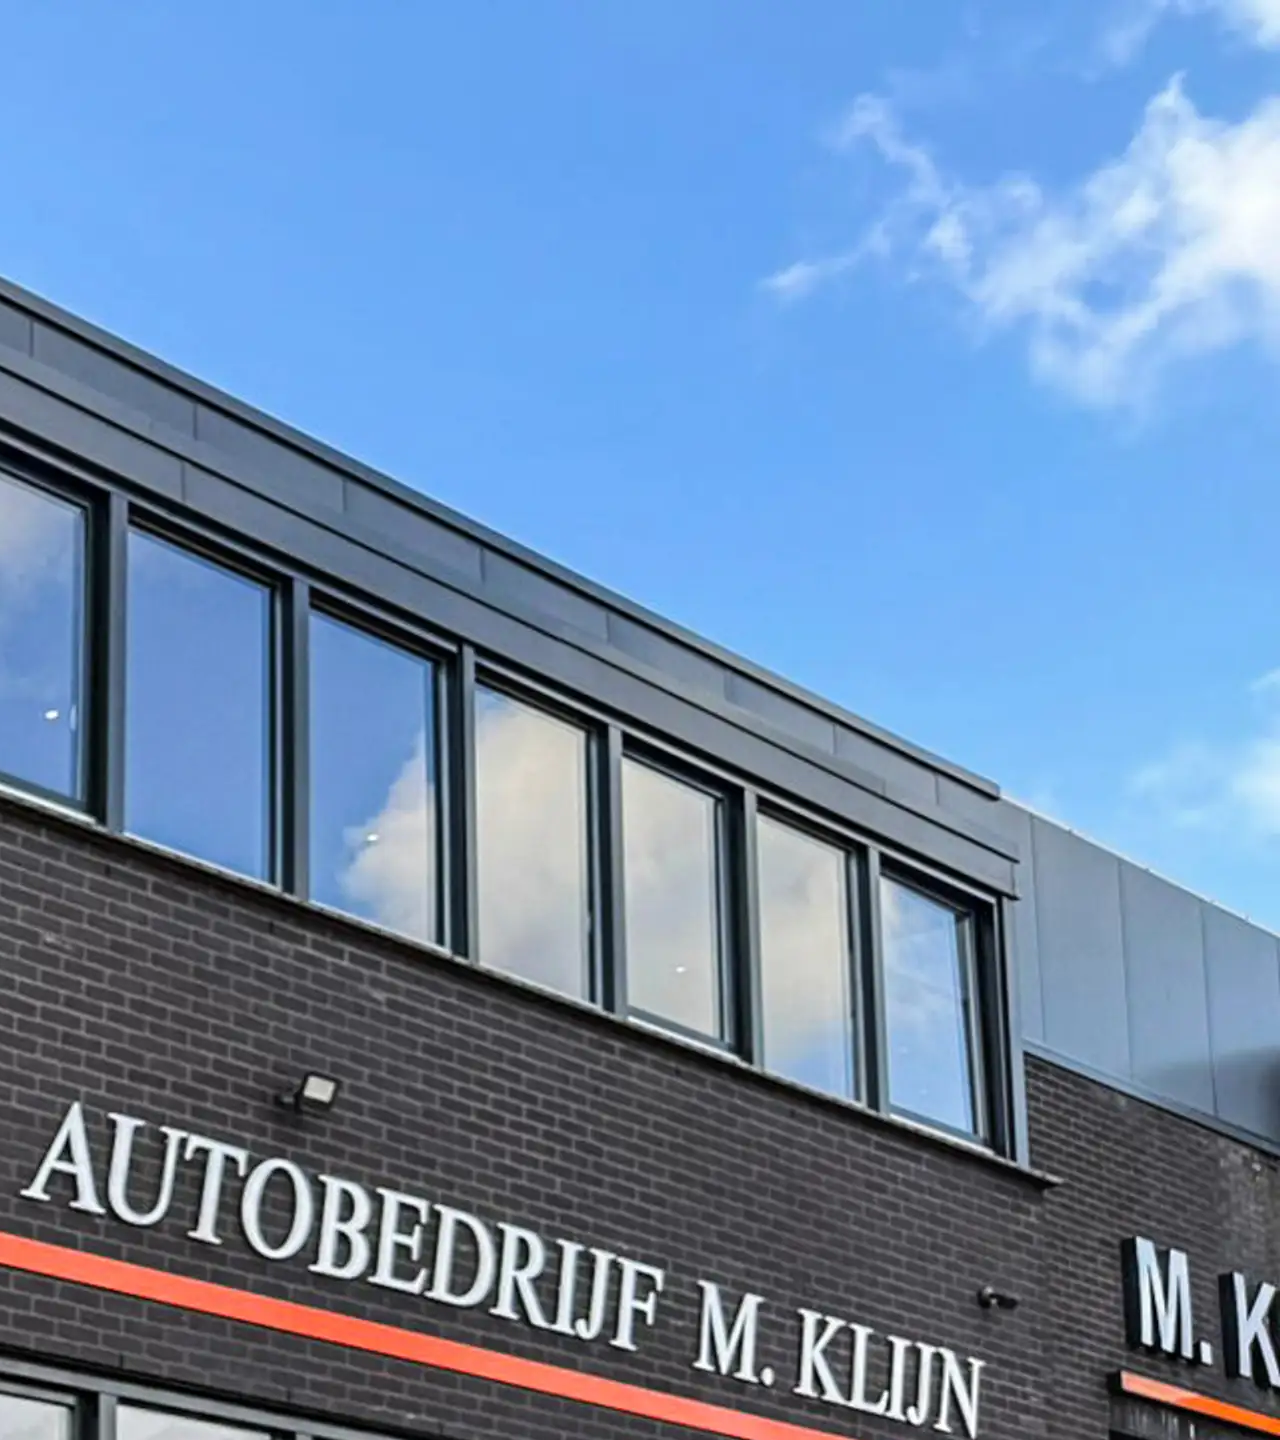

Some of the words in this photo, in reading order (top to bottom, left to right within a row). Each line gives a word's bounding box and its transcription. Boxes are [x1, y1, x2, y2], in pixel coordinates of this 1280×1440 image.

[20, 1101, 665, 1352] AUTOBEDRIJF
[692, 1280, 777, 1387] M.
[793, 1307, 986, 1440] KLIJN
[1130, 1235, 1214, 1367] M.
